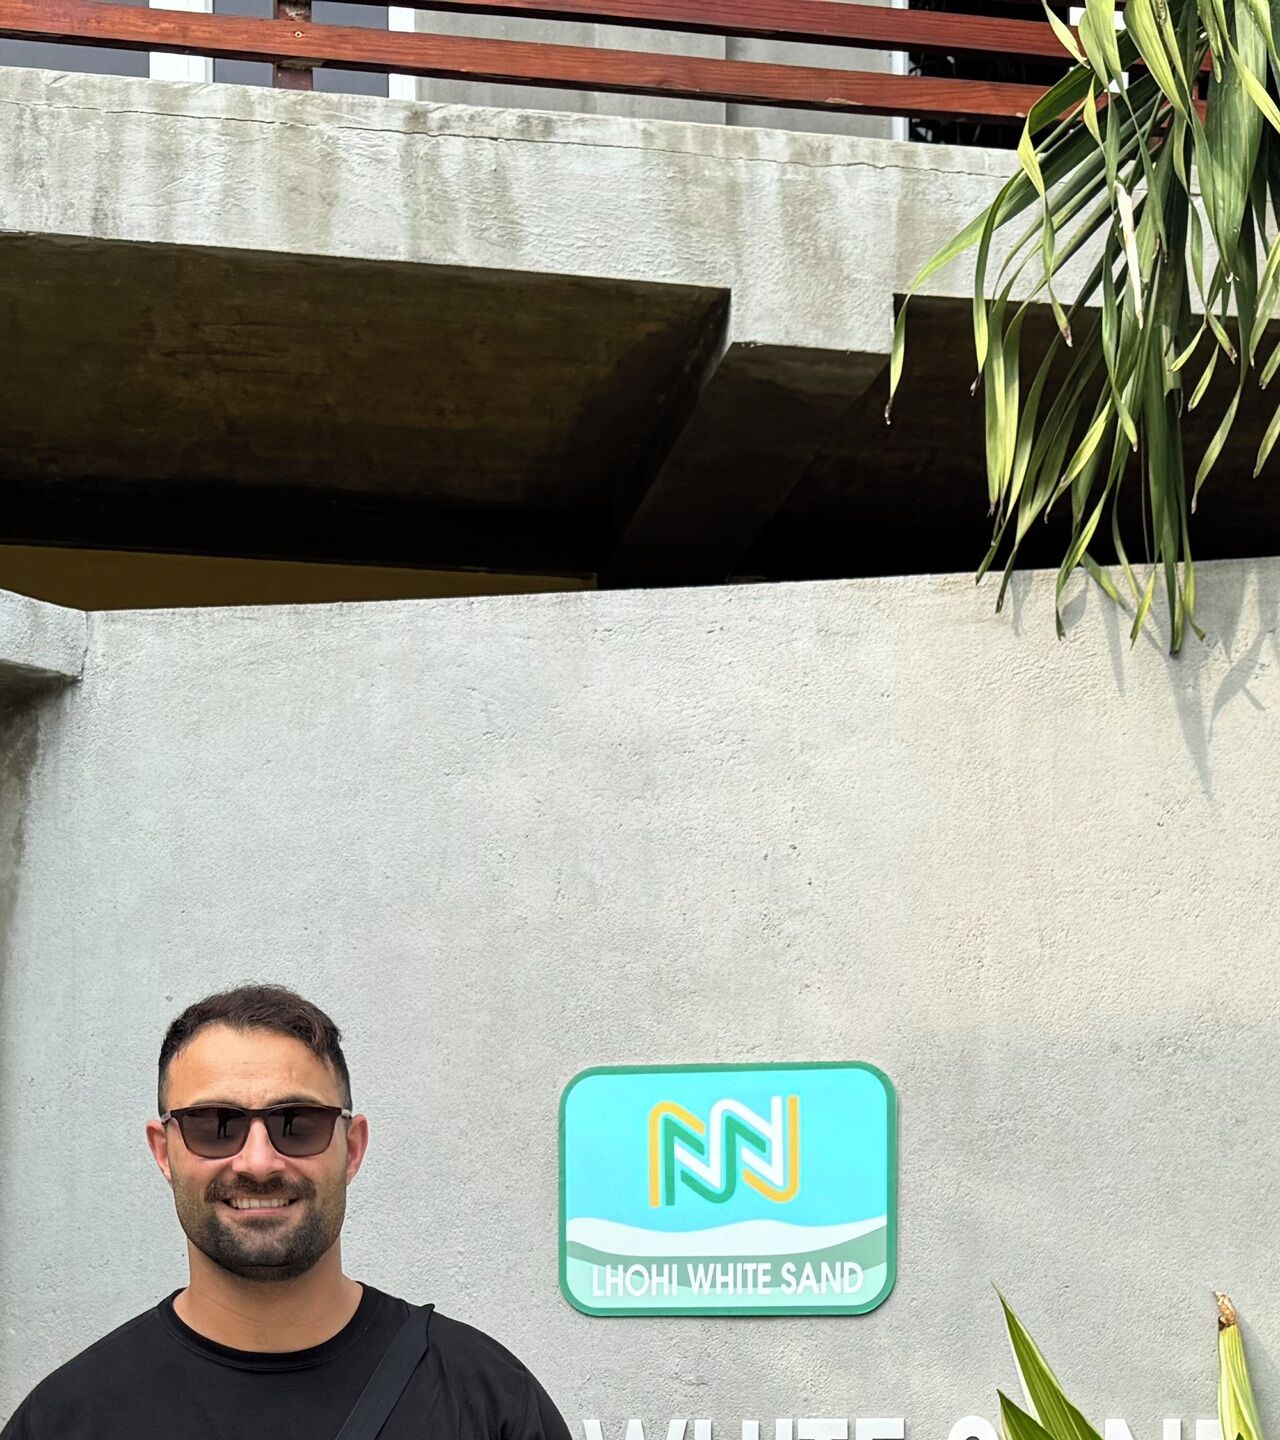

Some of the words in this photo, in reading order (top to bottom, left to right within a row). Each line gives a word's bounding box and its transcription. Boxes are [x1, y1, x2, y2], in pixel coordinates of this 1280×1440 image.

[592, 1263, 678, 1297] LHOHI
[686, 1262, 772, 1296] WHITE
[780, 1261, 864, 1295] SAND
